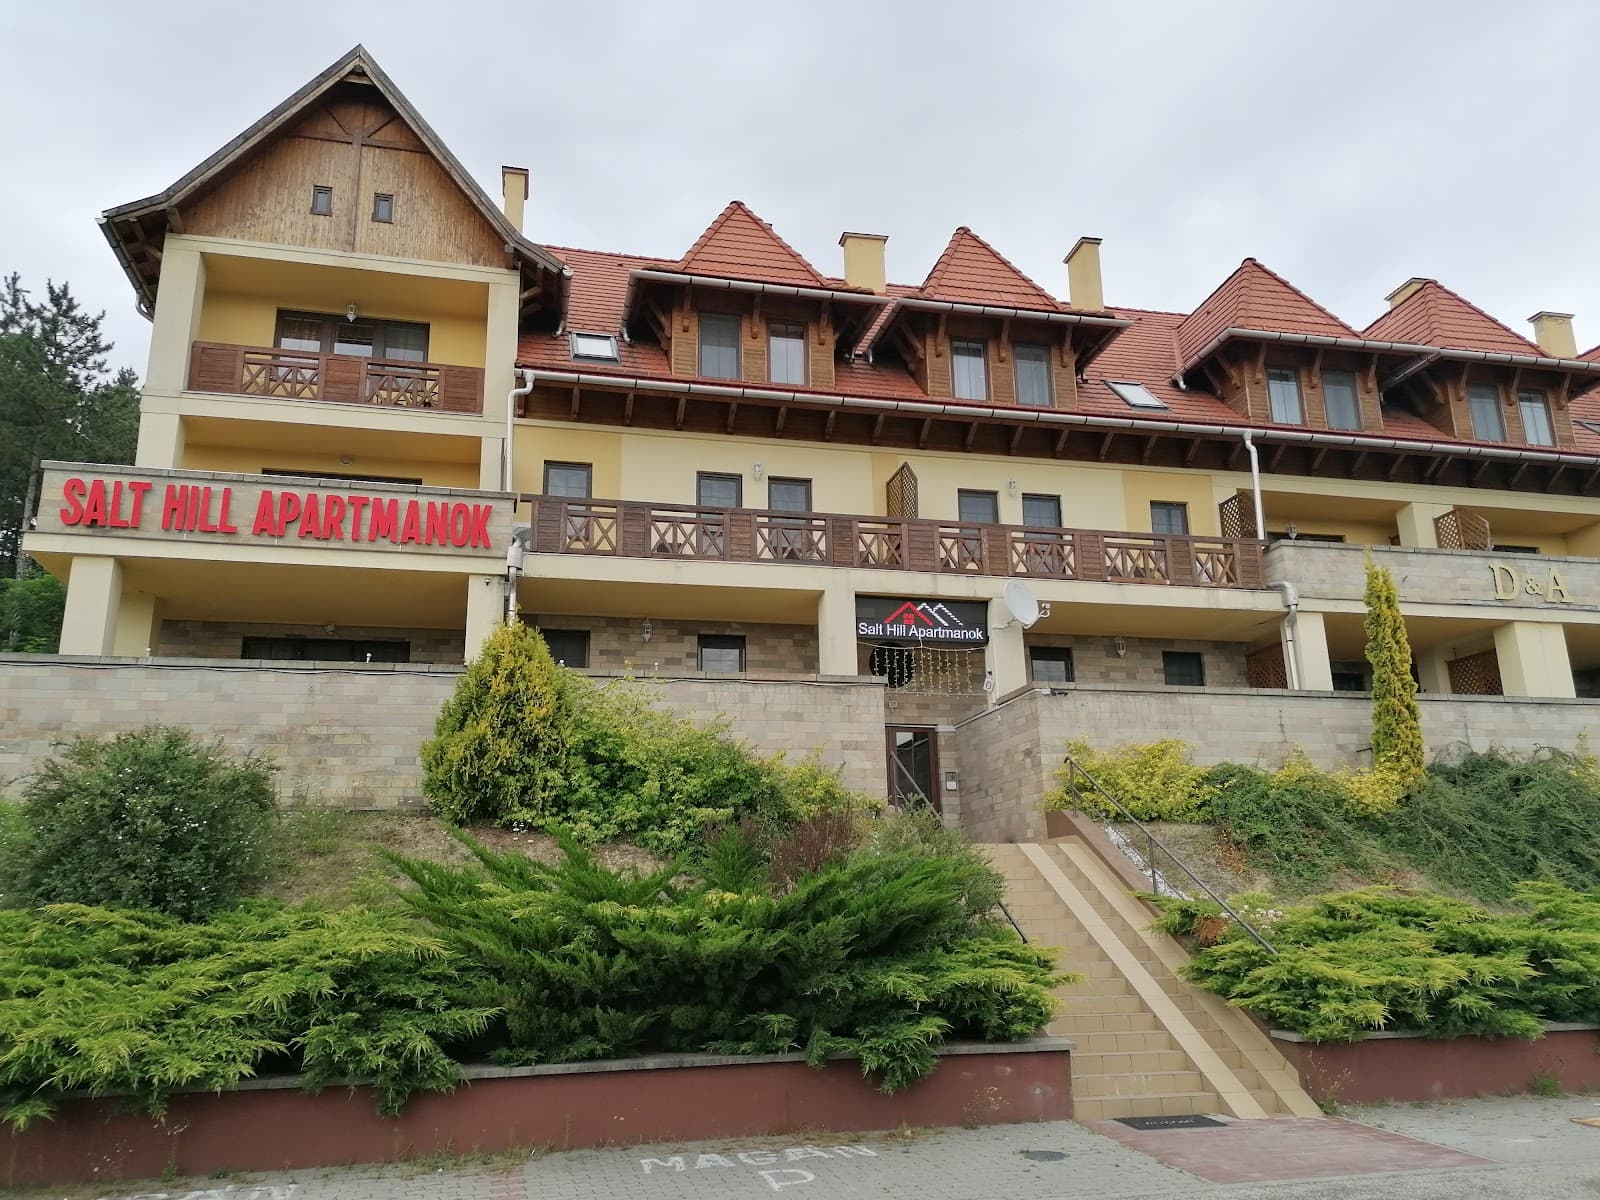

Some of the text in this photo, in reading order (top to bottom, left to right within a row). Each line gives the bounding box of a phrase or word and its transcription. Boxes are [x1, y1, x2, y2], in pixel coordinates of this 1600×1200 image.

[59, 477, 493, 549] SALT HILL APARTMANOK
[858, 623, 983, 640] Salt Hill Apartmanok
